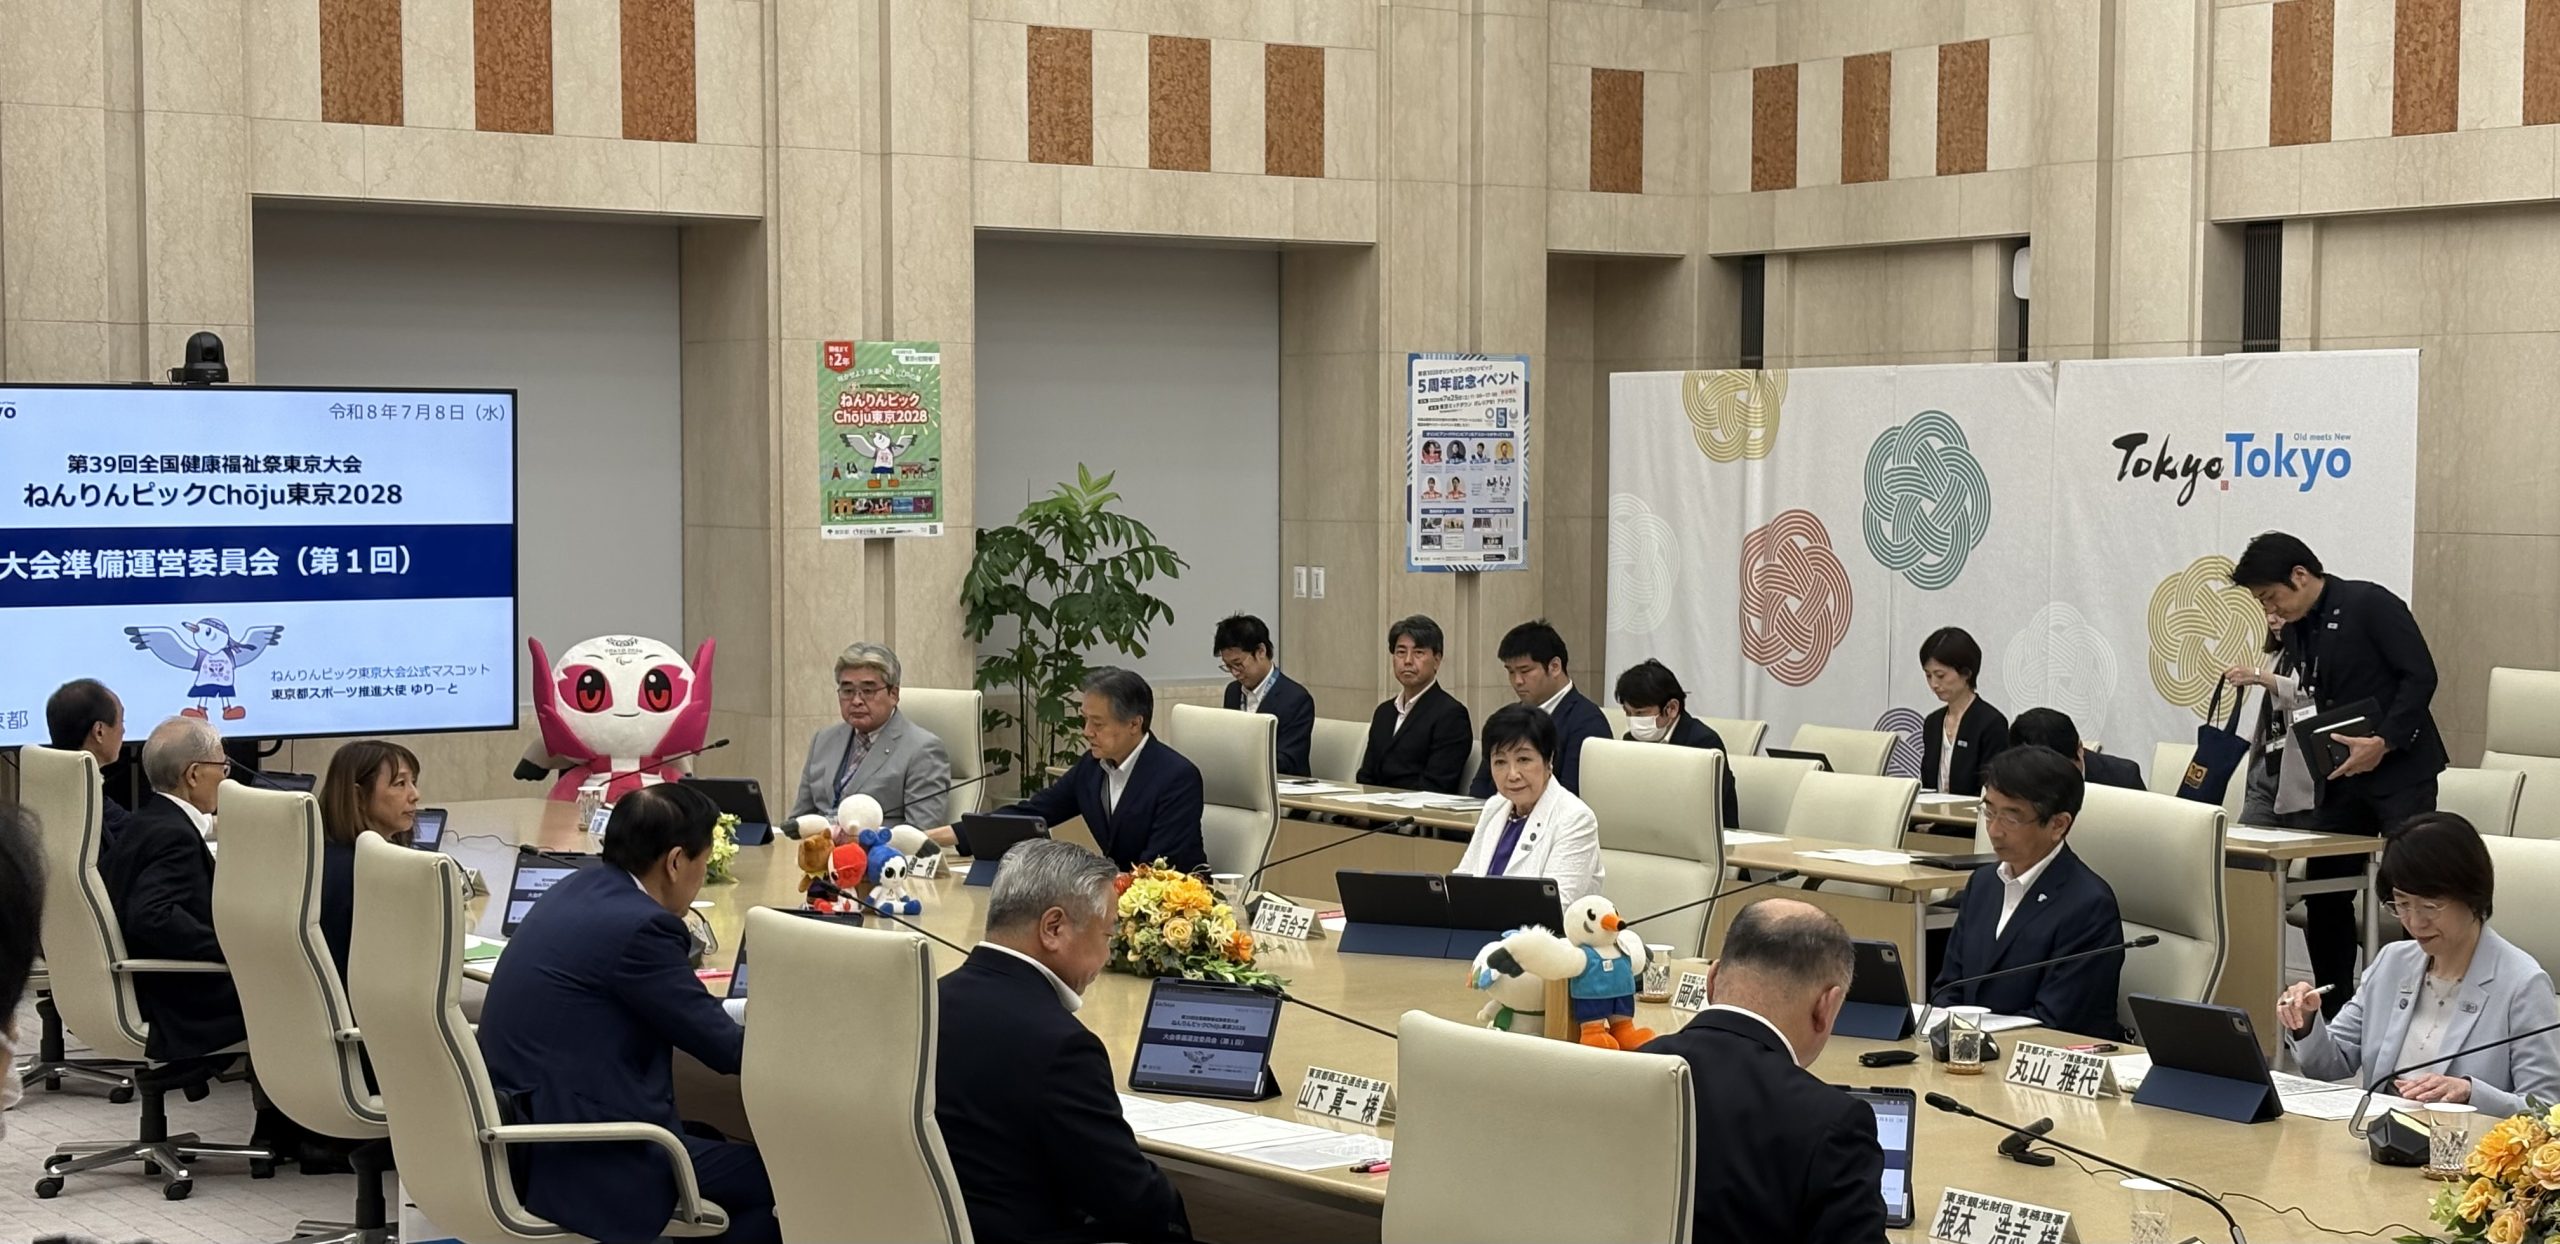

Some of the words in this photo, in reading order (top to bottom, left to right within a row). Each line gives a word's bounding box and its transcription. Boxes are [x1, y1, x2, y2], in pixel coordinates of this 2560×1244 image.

[1418, 371, 1519, 393] 5周年記念イベント
[840, 392, 920, 408] ねんりんピック
[834, 410, 928, 426] Chōju東京2028
[67, 454, 362, 474] 第39回全国健康福祉祭東京大会
[2112, 432, 2224, 506] Tokyo
[2225, 433, 2351, 492] Tokyo
[24, 481, 403, 509] ねんりんピックChōju東京2028
[271, 664, 490, 682] ねんりんピック東京大会公式マスコット
[271, 684, 407, 700] 東京都スポーツ推進大使
[411, 682, 459, 695] ゆりーと
[0, 710, 29, 729] 都
[1255, 910, 1277, 931] 小池
[1278, 914, 1309, 937] 百合子
[2010, 1054, 2051, 1086] 丸山
[2057, 1063, 2099, 1095] 雅代
[1297, 1081, 1329, 1110] 山下
[1328, 1086, 1357, 1116] 真一
[1361, 1093, 1380, 1122] 様
[1945, 1191, 2013, 1215] 東京観光財団
[2018, 1207, 2066, 1225] 専務理事
[1937, 1204, 1977, 1242] 根本
